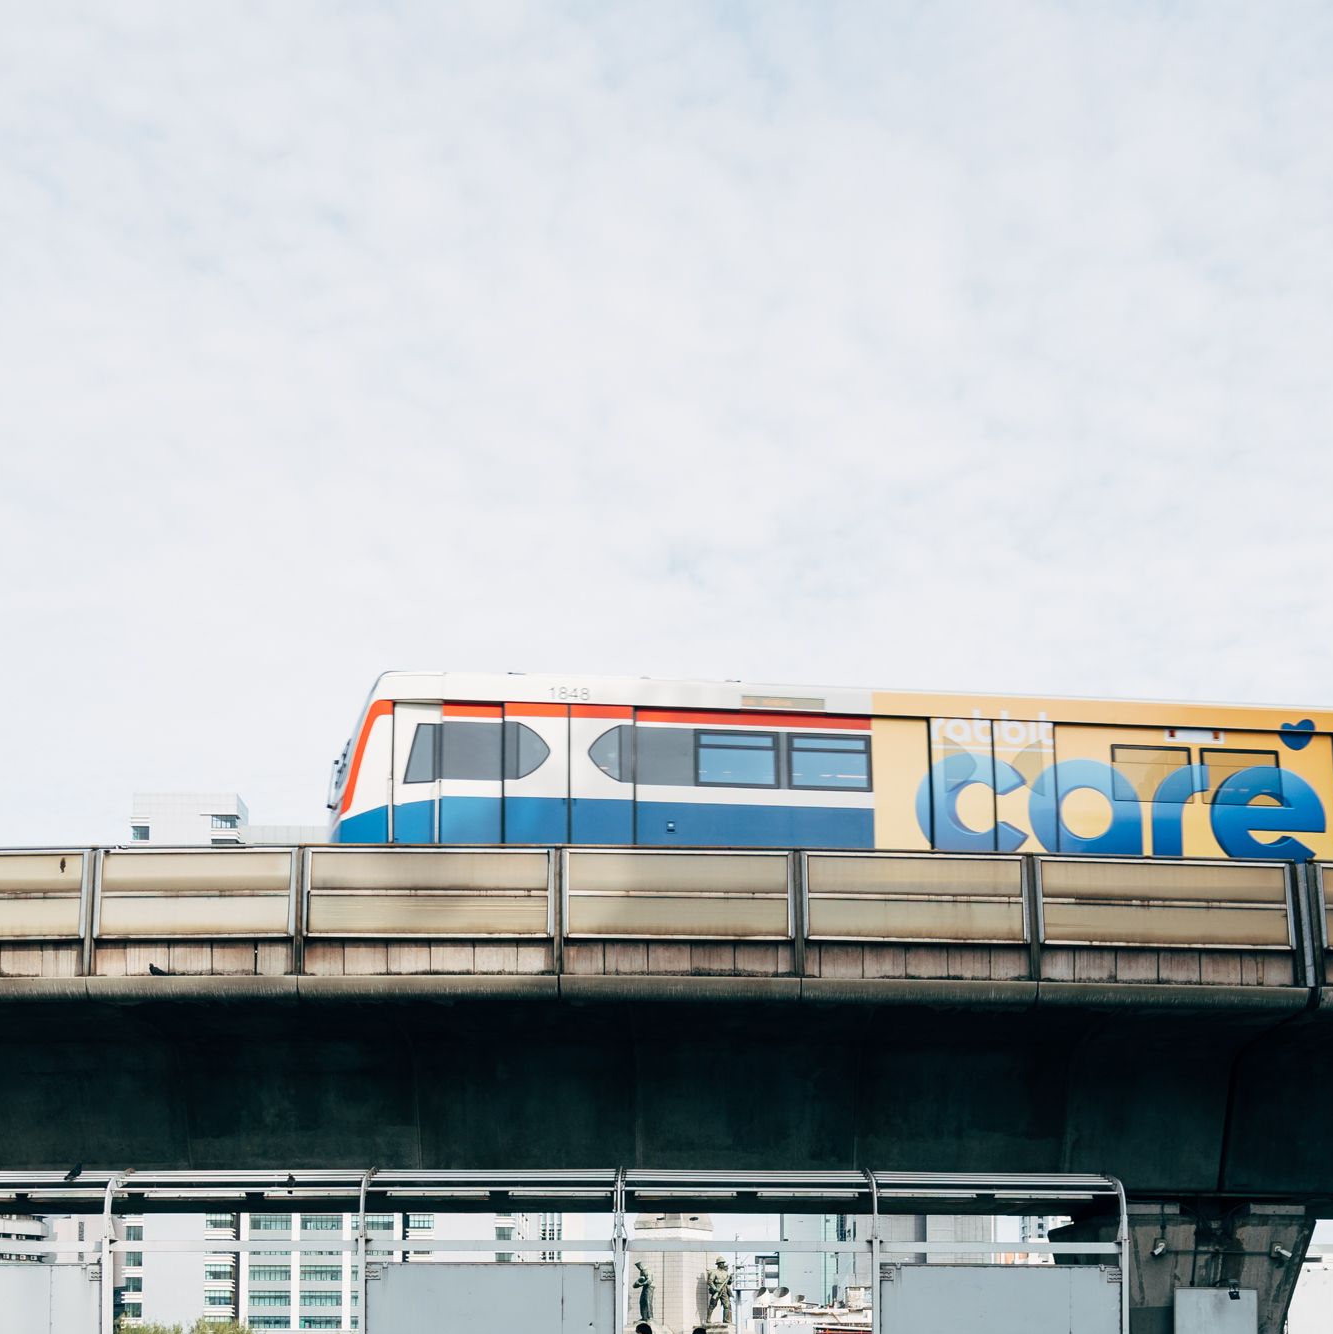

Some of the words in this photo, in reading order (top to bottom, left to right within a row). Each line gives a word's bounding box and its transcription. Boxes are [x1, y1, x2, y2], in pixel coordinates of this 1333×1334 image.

[549, 686, 590, 701] 1848
[930, 709, 1054, 746] rabbit
[916, 752, 1326, 858] care
